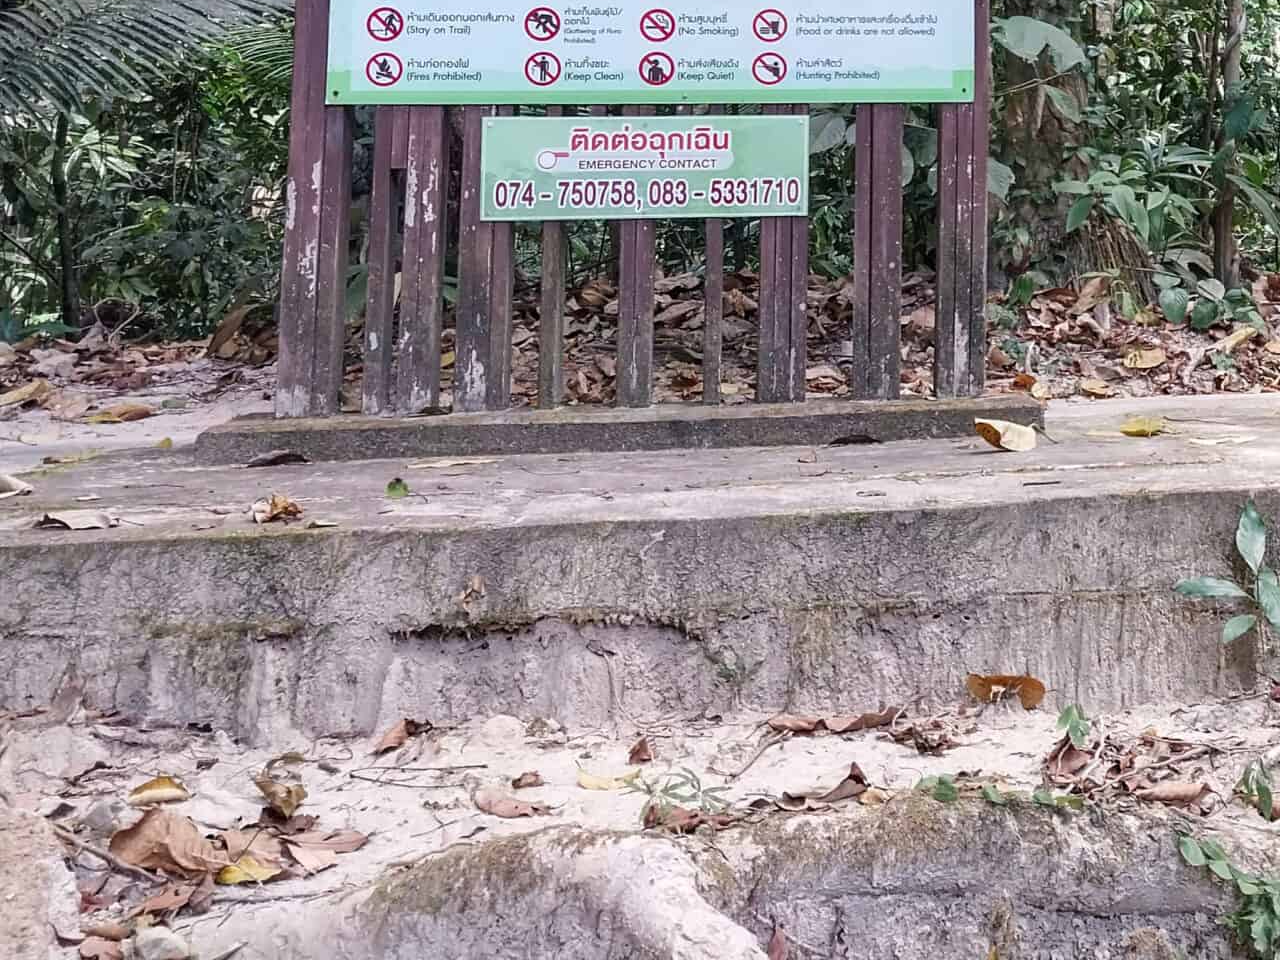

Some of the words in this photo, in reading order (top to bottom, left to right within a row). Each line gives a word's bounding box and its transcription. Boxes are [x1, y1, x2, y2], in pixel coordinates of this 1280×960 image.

[407, 25, 430, 37] (Stay
[434, 27, 446, 36] on
[449, 25, 471, 37] Trail)
[678, 25, 695, 37] (No
[698, 25, 740, 38] Smoking)
[407, 71, 430, 83] (Fires
[434, 71, 482, 83] Prohibited)
[564, 72, 591, 83] (Keep
[594, 71, 624, 82] Clean)
[677, 71, 704, 83] (Keep
[707, 71, 735, 83] Quiet)
[796, 71, 832, 83] (Hunting
[570, 124, 730, 158] ติดต่อฉุกเฉิน
[578, 158, 656, 171] EMERGENCY
[658, 158, 717, 170] CONTACT
